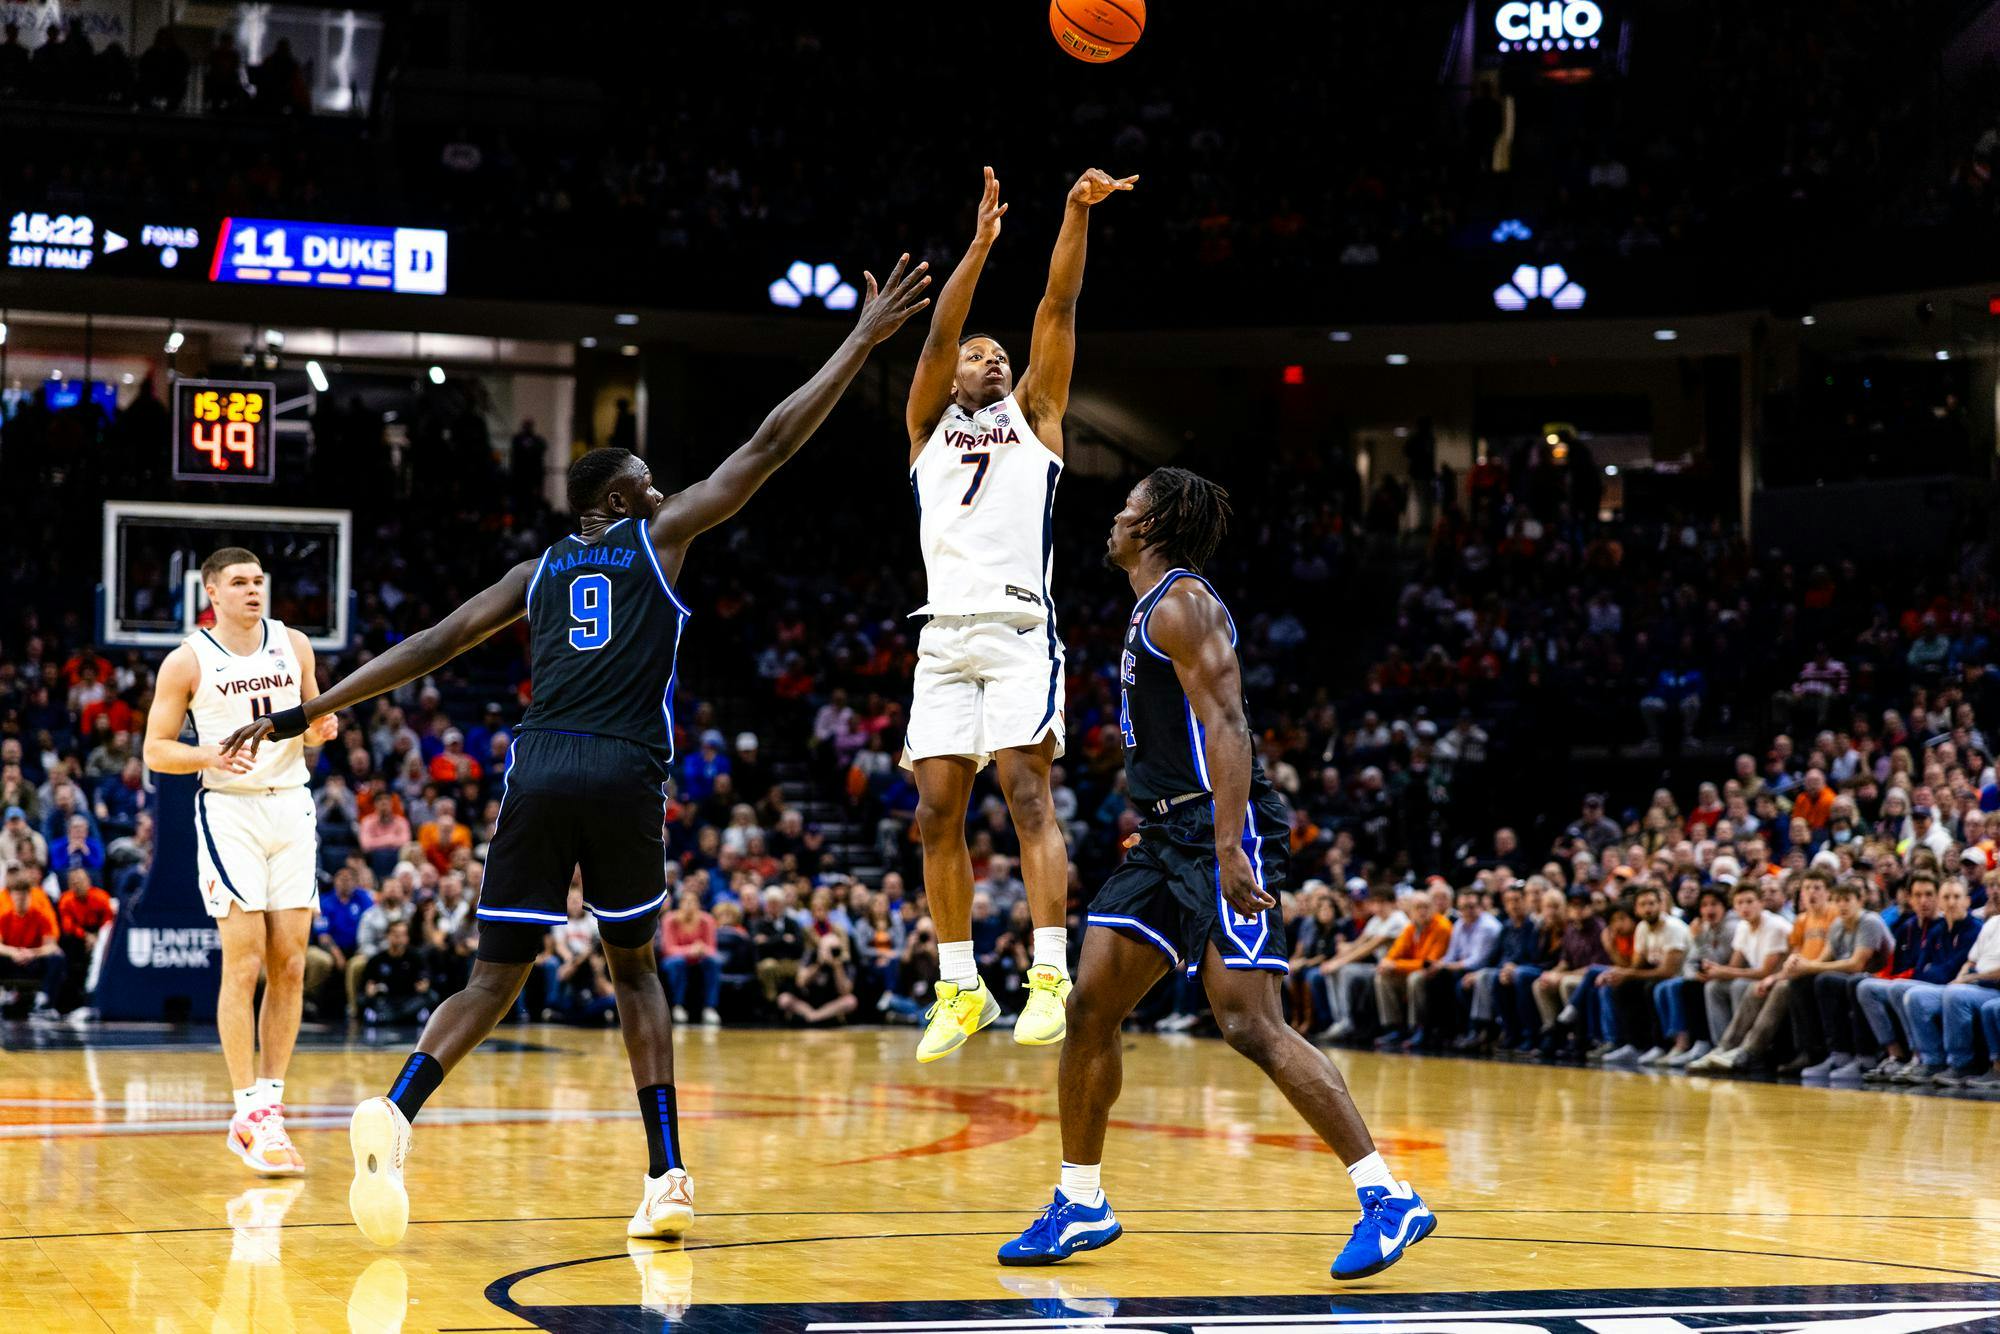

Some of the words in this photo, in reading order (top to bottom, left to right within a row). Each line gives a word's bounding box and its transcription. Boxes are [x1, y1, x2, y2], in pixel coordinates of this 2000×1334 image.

[1495, 0, 1602, 40] CHO
[45, 248, 93, 269] HALF
[232, 226, 294, 268] 11
[302, 235, 392, 271] DUKE
[194, 391, 262, 423] 15:22
[961, 452, 990, 506] 7
[548, 546, 637, 577] MALUACH
[569, 573, 612, 651] 9
[216, 674, 294, 696] VIRGINIA
[151, 946, 210, 968] BANK
